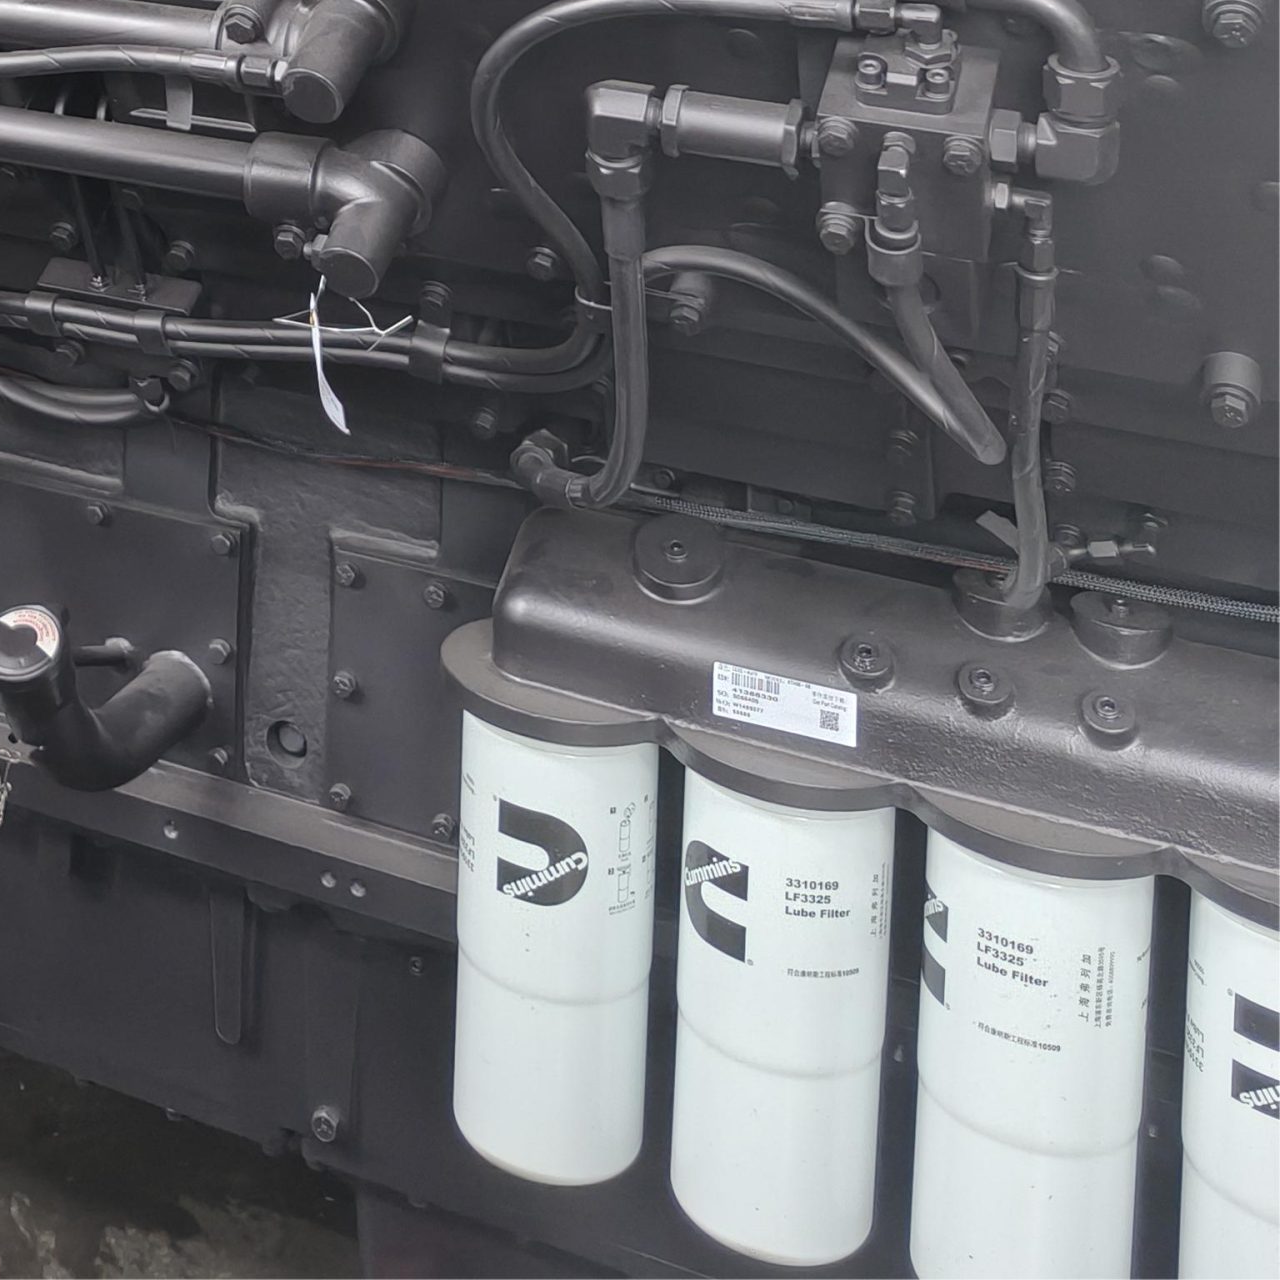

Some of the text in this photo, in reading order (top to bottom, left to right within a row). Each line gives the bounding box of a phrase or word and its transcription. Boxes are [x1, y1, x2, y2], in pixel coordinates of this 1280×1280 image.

[503, 851, 588, 897] Cummins
[685, 856, 741, 886] Cummins
[785, 878, 839, 891] 3310169
[785, 891, 832, 904] LF3325
[785, 906, 851, 919] Lube Filter
[976, 941, 1024, 966] LF3325
[977, 927, 1033, 955] 3310169
[976, 957, 1049, 988] Lube Filter
